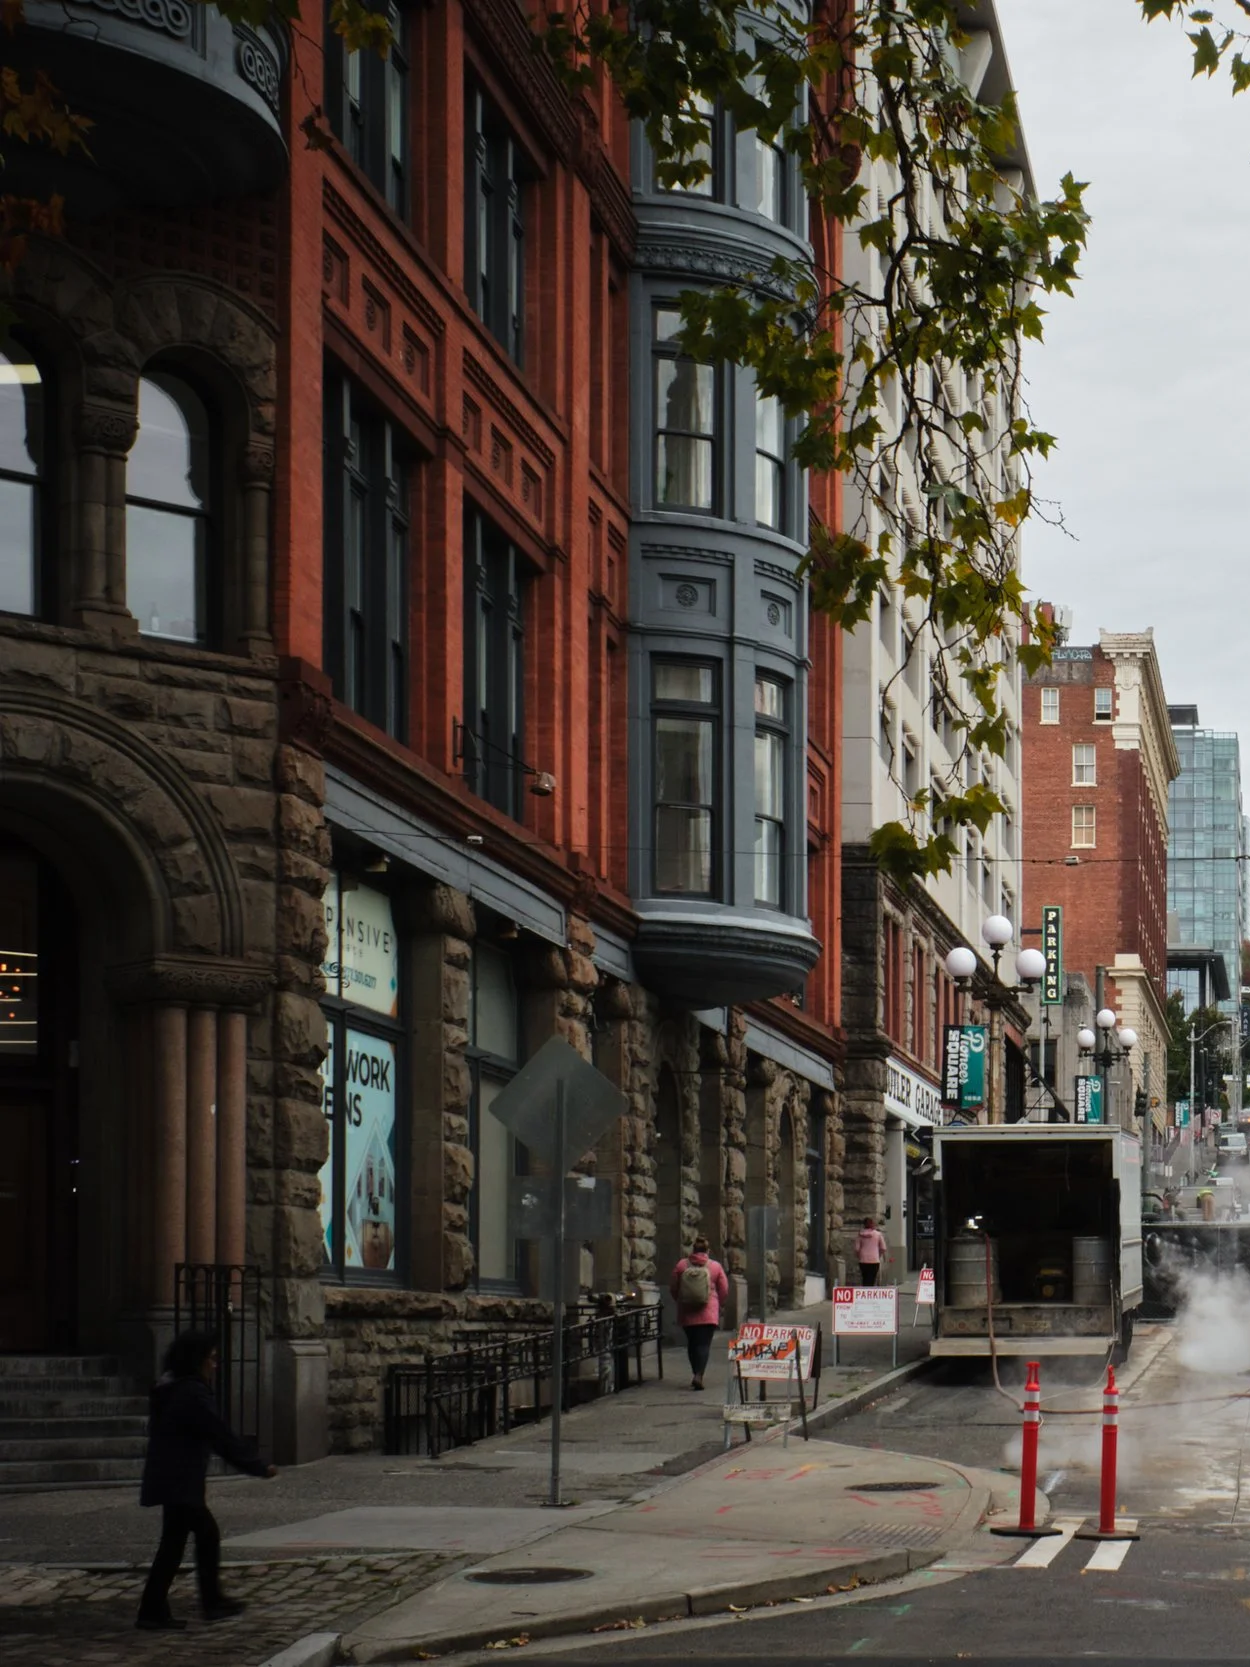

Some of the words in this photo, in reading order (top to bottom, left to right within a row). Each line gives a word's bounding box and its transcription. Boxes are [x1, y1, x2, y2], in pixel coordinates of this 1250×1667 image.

[1047, 911, 1057, 998] PARKING
[346, 1049, 390, 1093] WORK
[946, 1030, 960, 1100] SQUARE
[960, 1030, 985, 1085] Pioneer
[887, 1065, 911, 1108] UTLER
[836, 1289, 851, 1302] NO
[855, 1290, 894, 1300] PARKING
[922, 1271, 934, 1280] NO
[743, 1326, 761, 1339] NO
[766, 1328, 812, 1340] PARKNG
